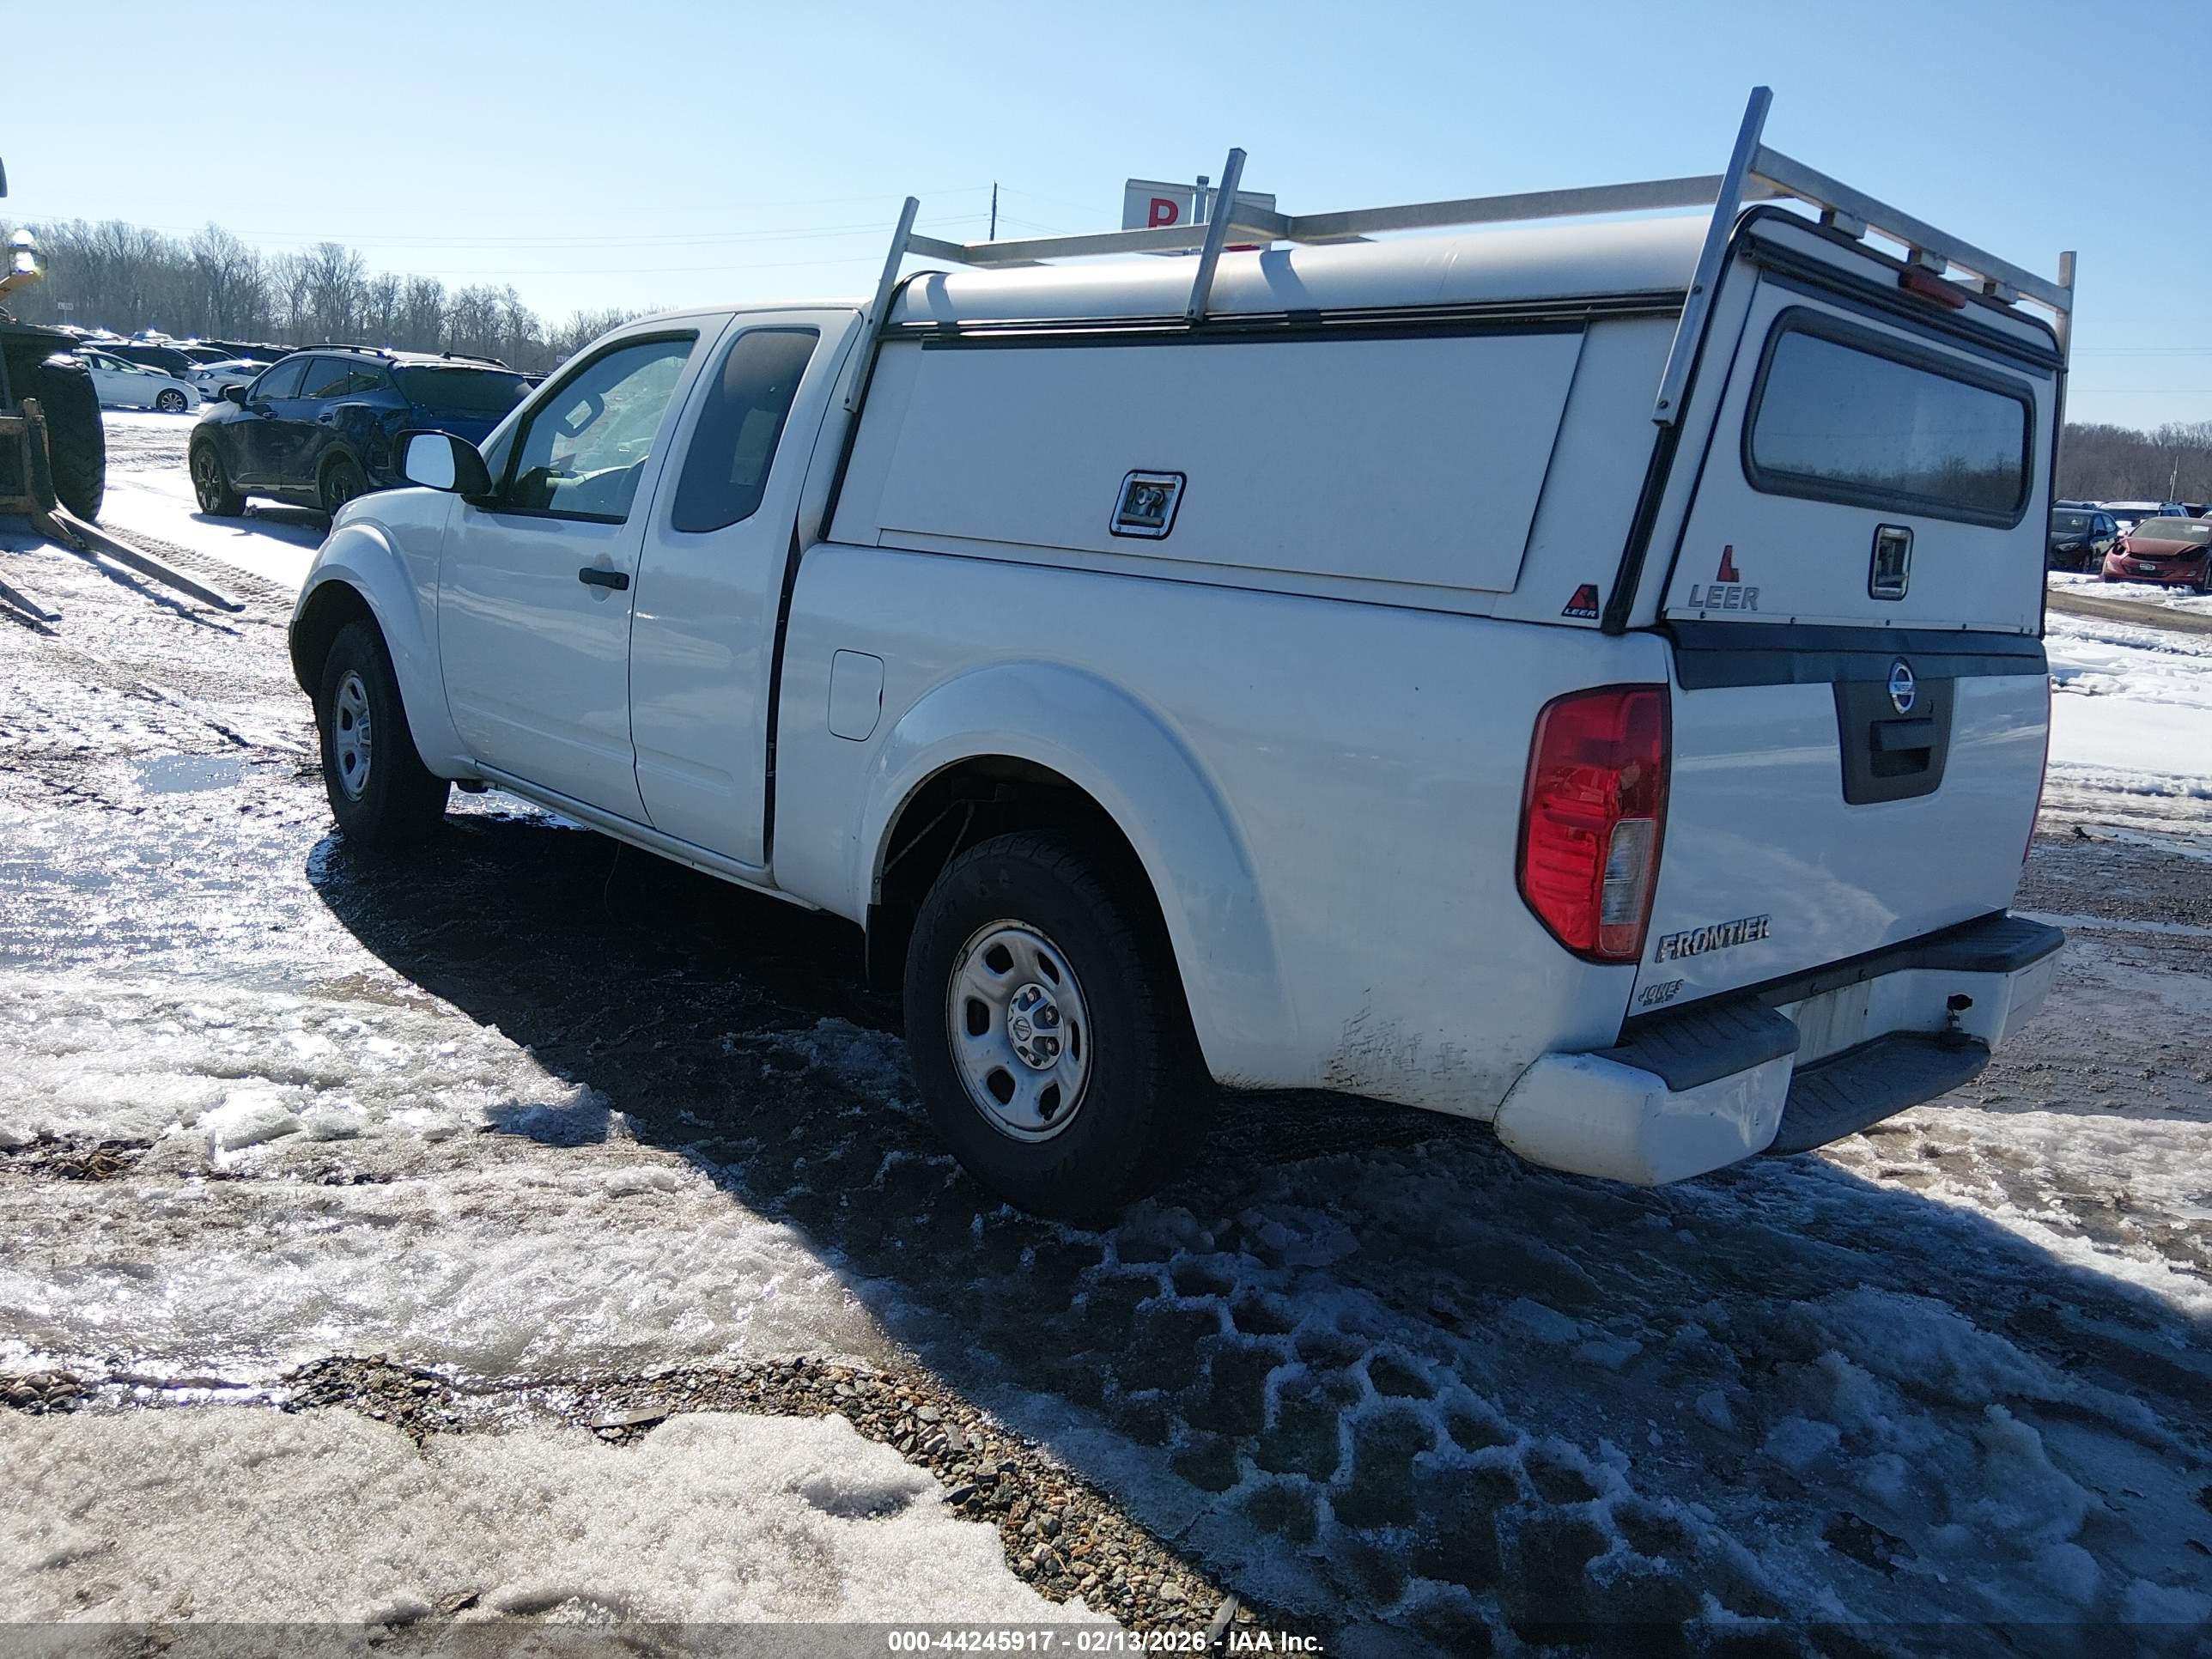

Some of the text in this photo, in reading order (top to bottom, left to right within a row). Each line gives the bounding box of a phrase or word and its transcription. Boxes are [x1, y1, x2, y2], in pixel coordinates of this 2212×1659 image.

[1688, 584, 1759, 611] LEER
[1564, 607, 1597, 617] LEER
[1655, 914, 1771, 963] FRONTIER
